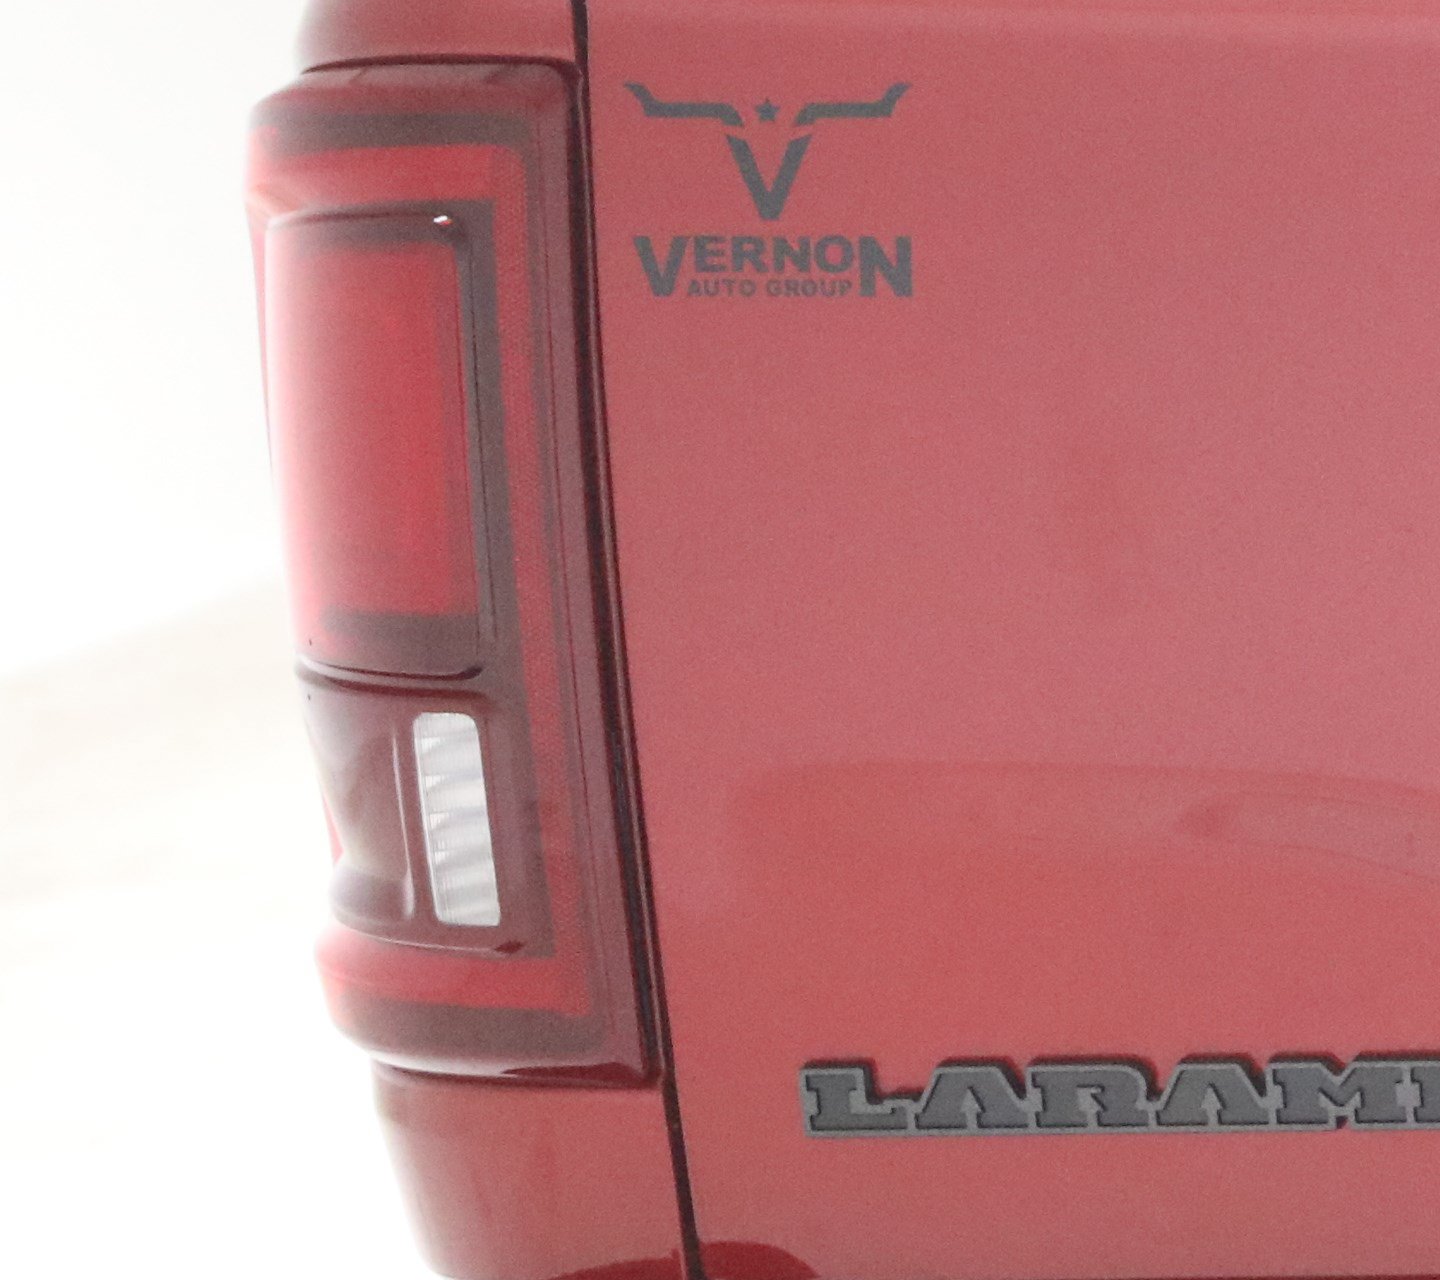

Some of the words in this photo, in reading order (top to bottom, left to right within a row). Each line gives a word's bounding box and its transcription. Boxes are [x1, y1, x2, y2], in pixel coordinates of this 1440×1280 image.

[633, 235, 913, 298] VERNON
[686, 278, 756, 297] AUTO
[765, 278, 853, 297] GROUP
